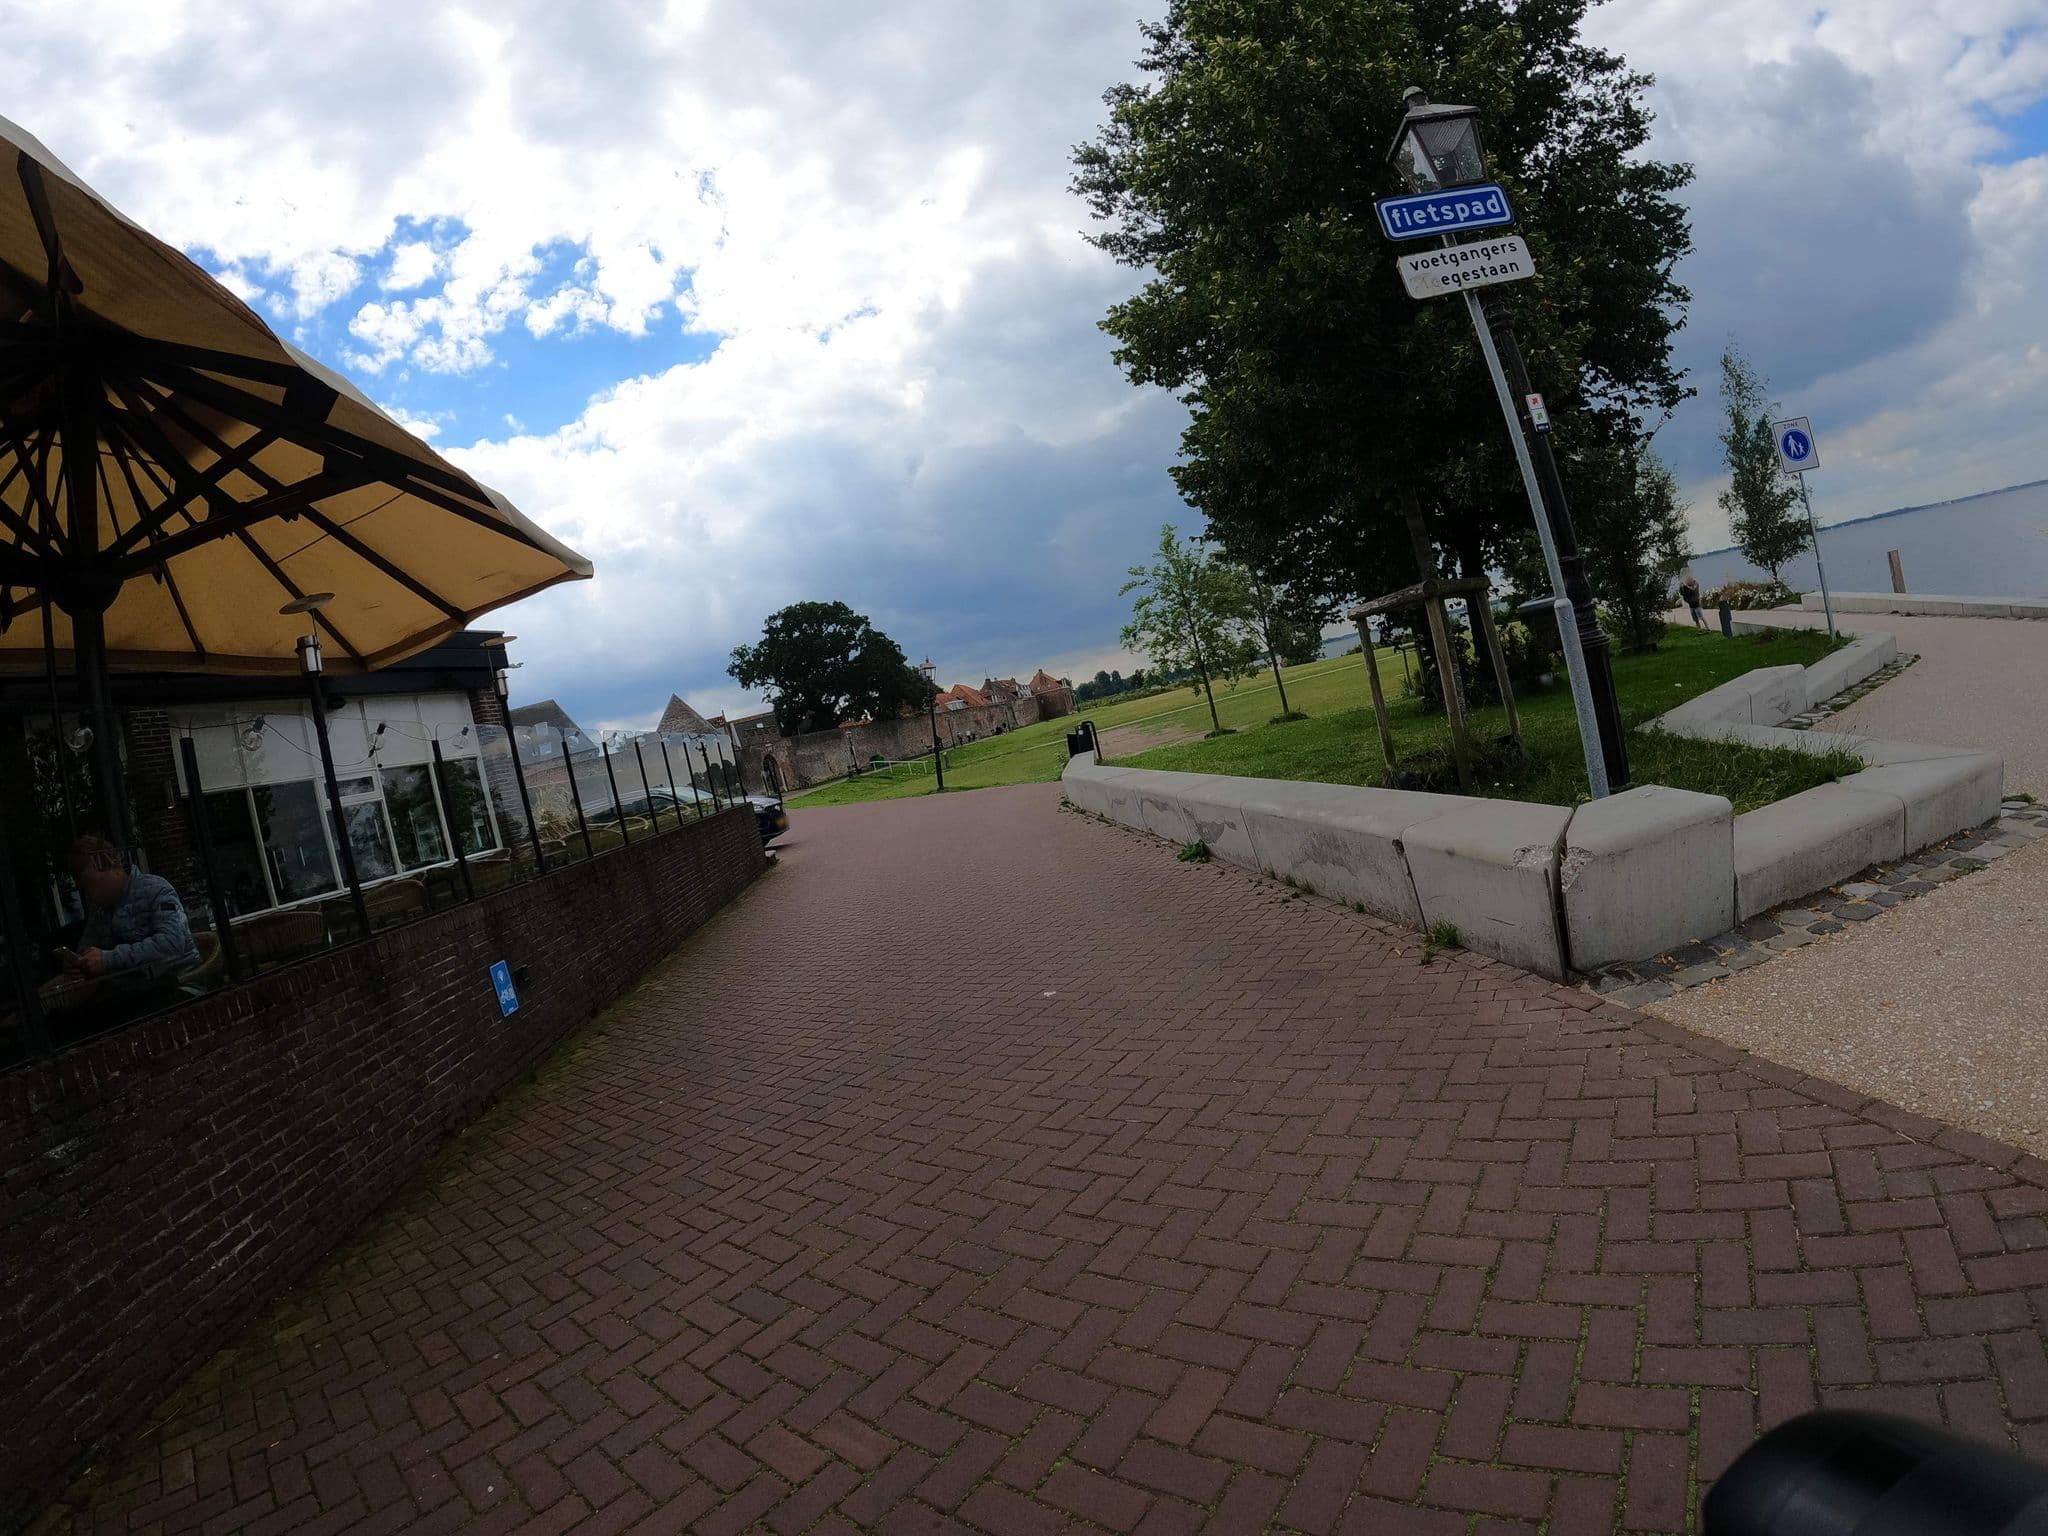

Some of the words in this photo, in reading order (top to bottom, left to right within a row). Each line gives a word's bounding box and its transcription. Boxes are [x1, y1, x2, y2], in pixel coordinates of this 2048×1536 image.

[1391, 194, 1502, 228] fietspad
[1409, 242, 1518, 271] voetgangers
[1424, 262, 1520, 288] egestaan
